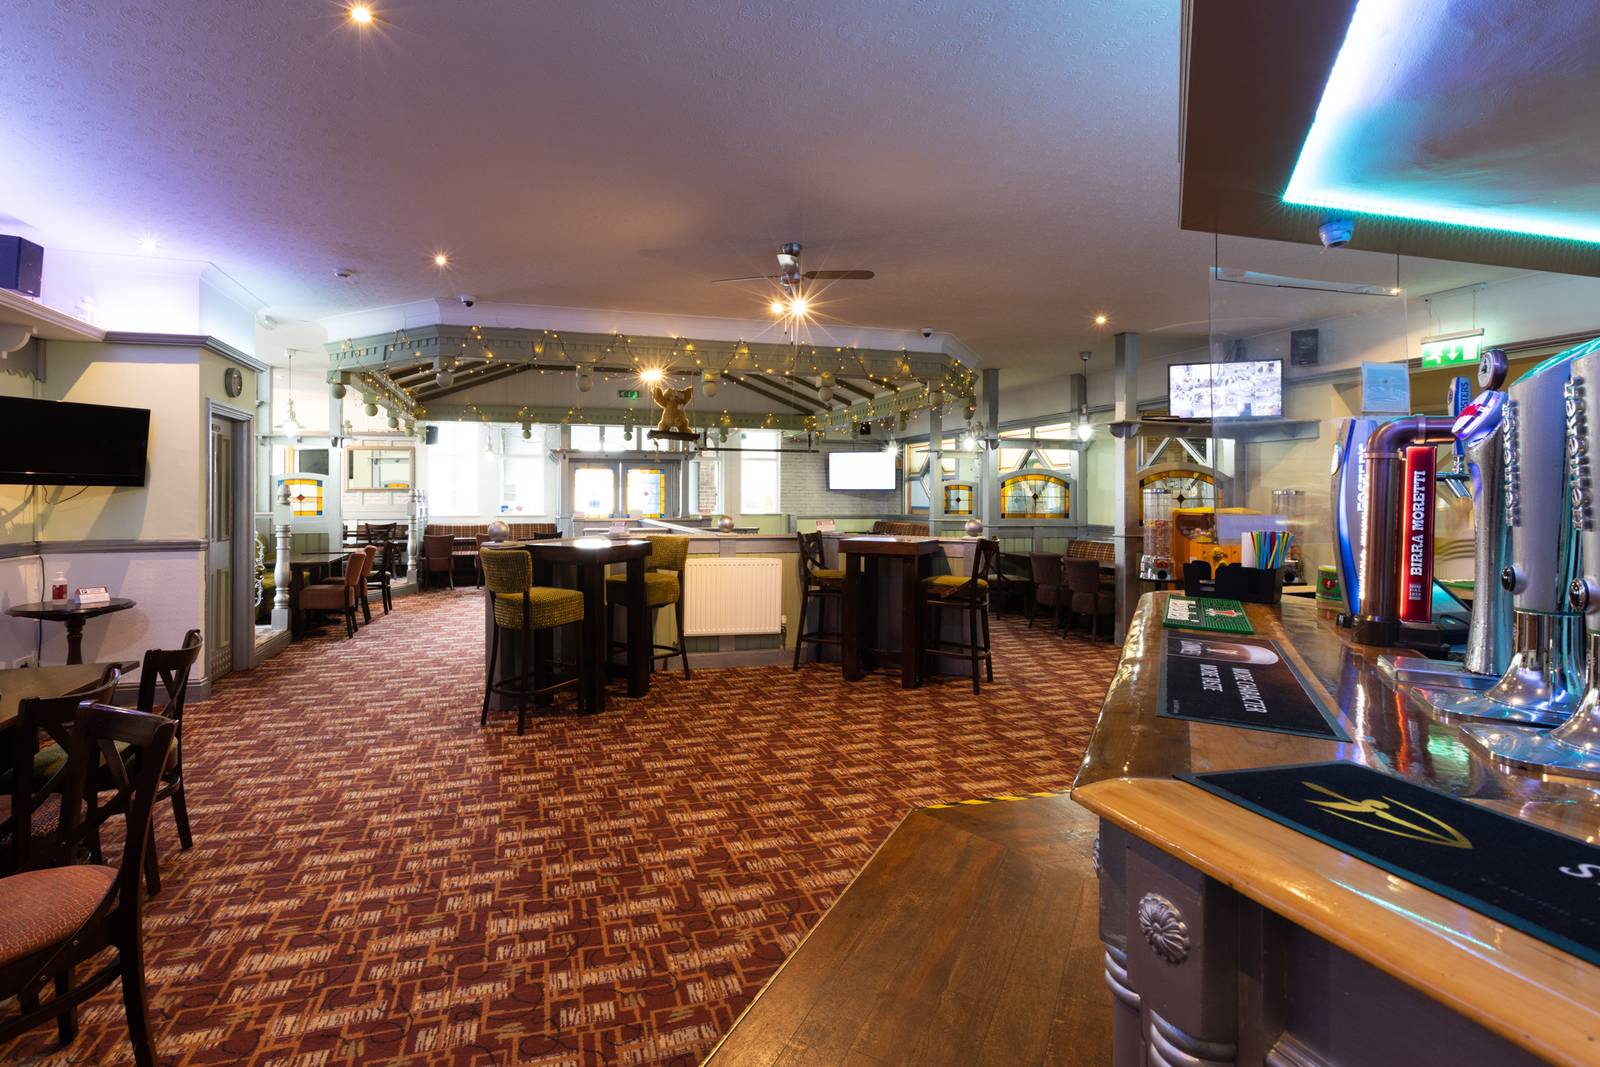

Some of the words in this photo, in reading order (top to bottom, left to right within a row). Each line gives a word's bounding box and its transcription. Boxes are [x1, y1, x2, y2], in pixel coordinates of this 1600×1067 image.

[1412, 470, 1426, 531] MORETTI
[1410, 535, 1424, 576] BIRRA
[1236, 681, 1268, 713] CHARACTER
